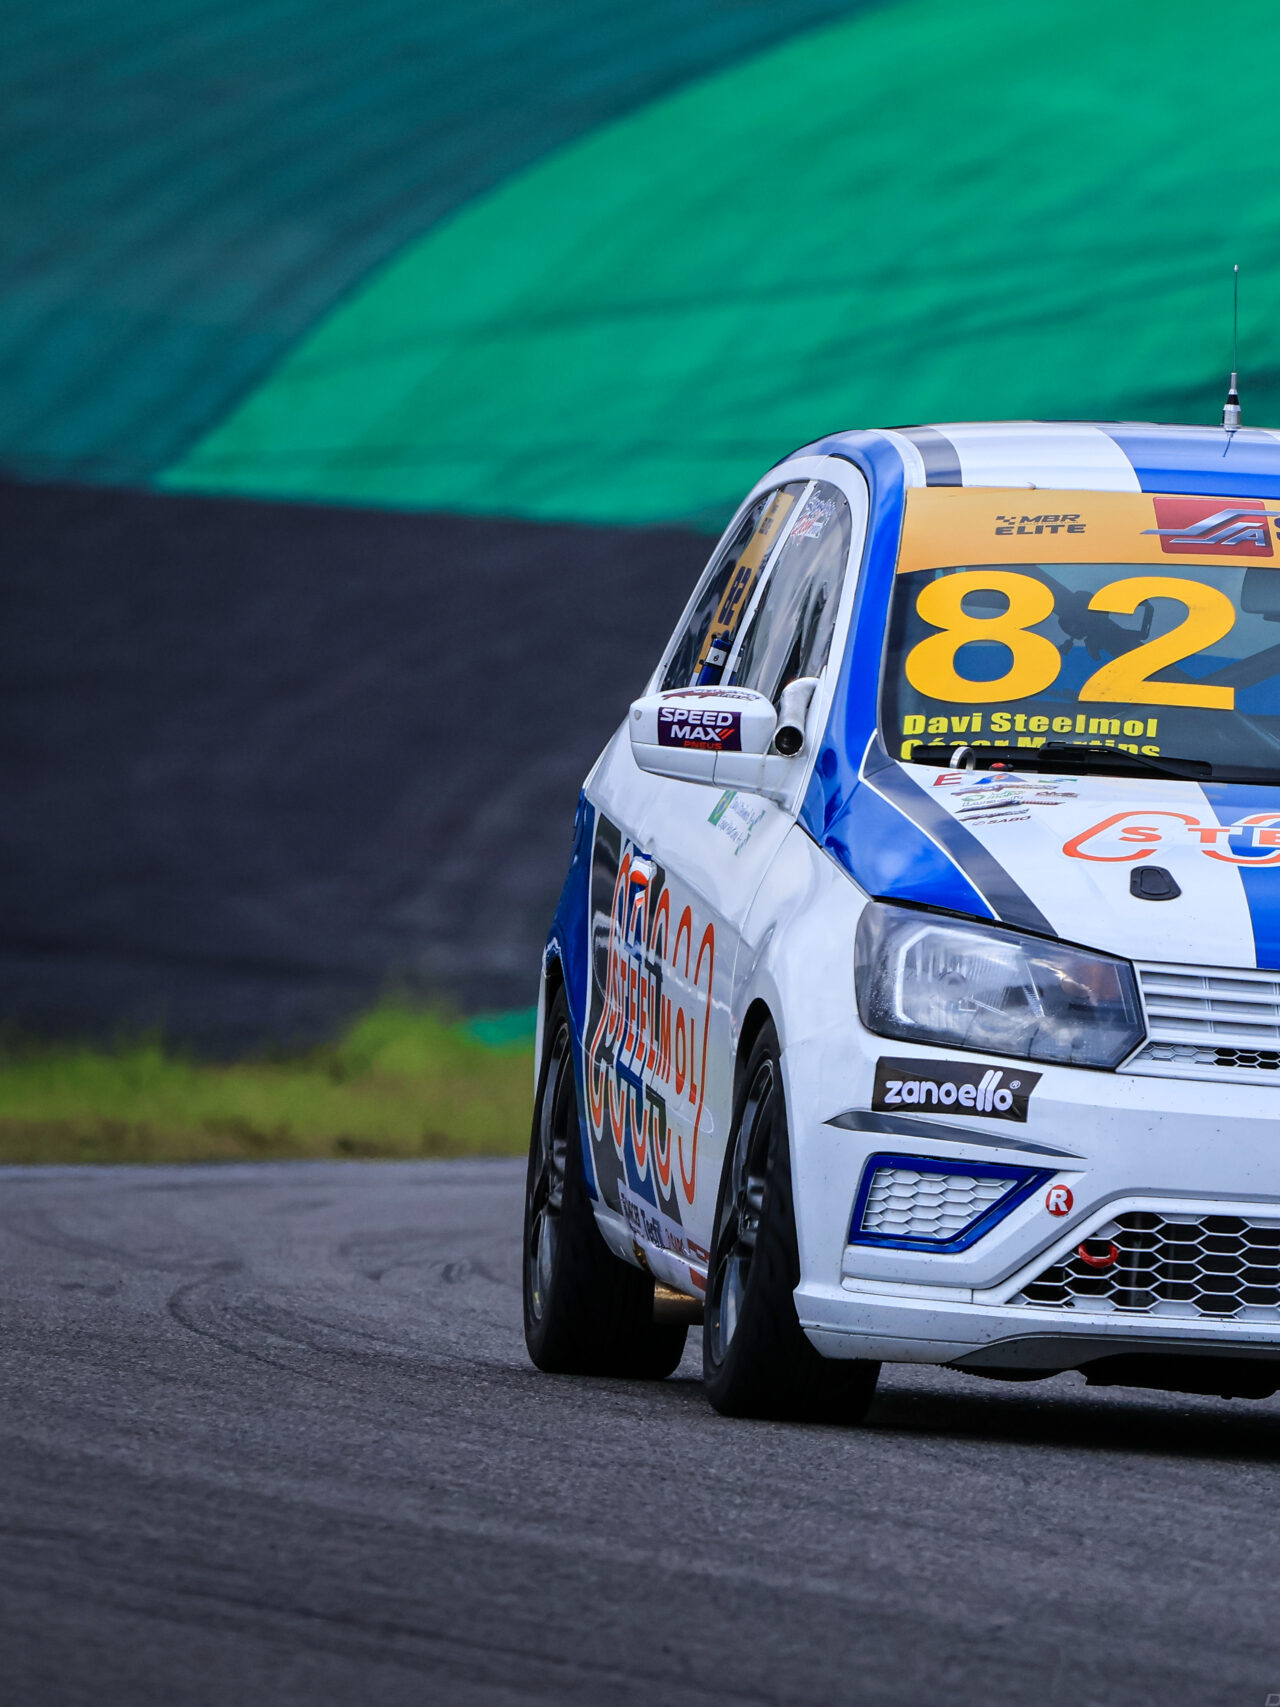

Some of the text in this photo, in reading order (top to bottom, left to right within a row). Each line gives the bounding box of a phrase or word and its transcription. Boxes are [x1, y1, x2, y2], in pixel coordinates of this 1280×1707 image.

[1019, 514, 1081, 523] MBR
[995, 524, 1087, 535] ELITE
[905, 570, 1236, 710] 82
[660, 708, 733, 726] SPEED
[903, 711, 1158, 738] Davi Steelmol
[670, 724, 722, 741] MAX
[683, 740, 723, 750] PNEUS
[608, 949, 698, 1106] STEELMOL
[1049, 1189, 1069, 1212] R
